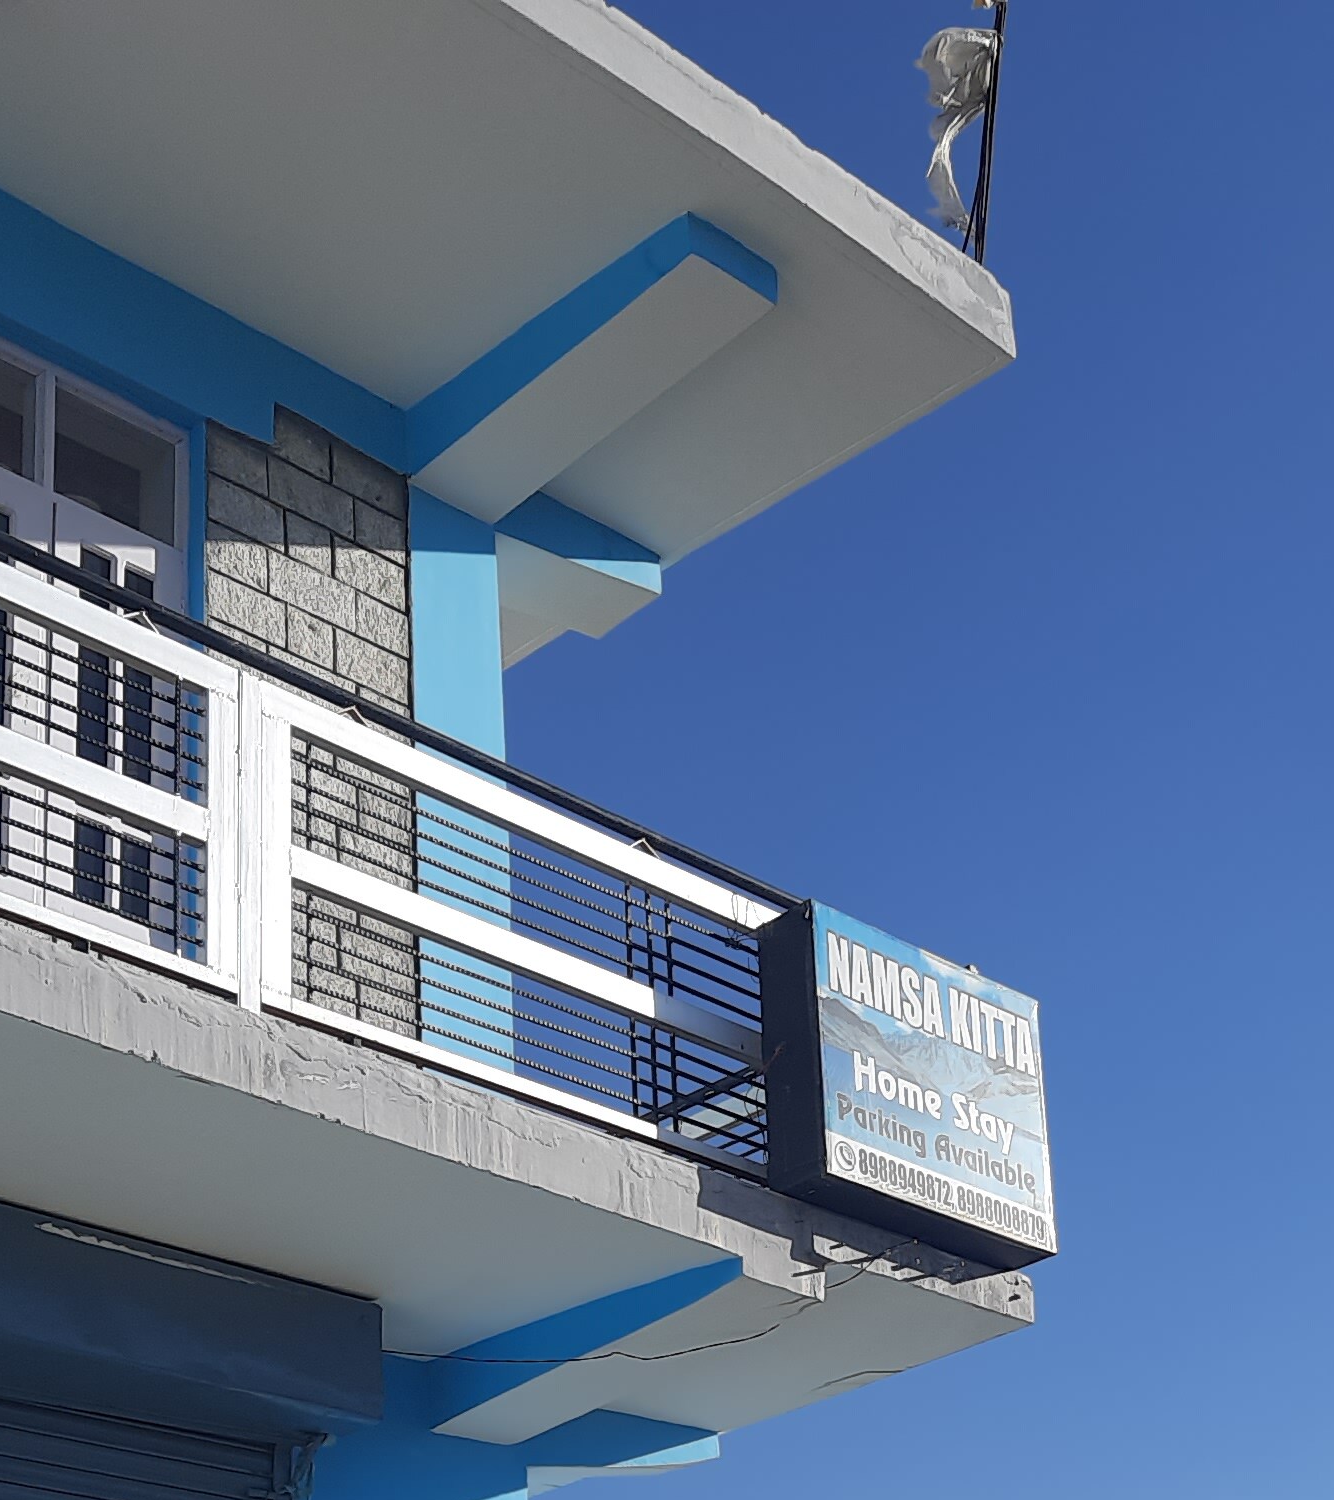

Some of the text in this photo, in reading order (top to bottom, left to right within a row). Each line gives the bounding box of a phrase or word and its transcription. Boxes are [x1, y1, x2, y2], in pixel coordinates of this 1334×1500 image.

[827, 930, 1037, 1076] NAMSA KITTA
[837, 1093, 1036, 1195] Parking Available
[852, 1051, 1014, 1156] Home Stay
